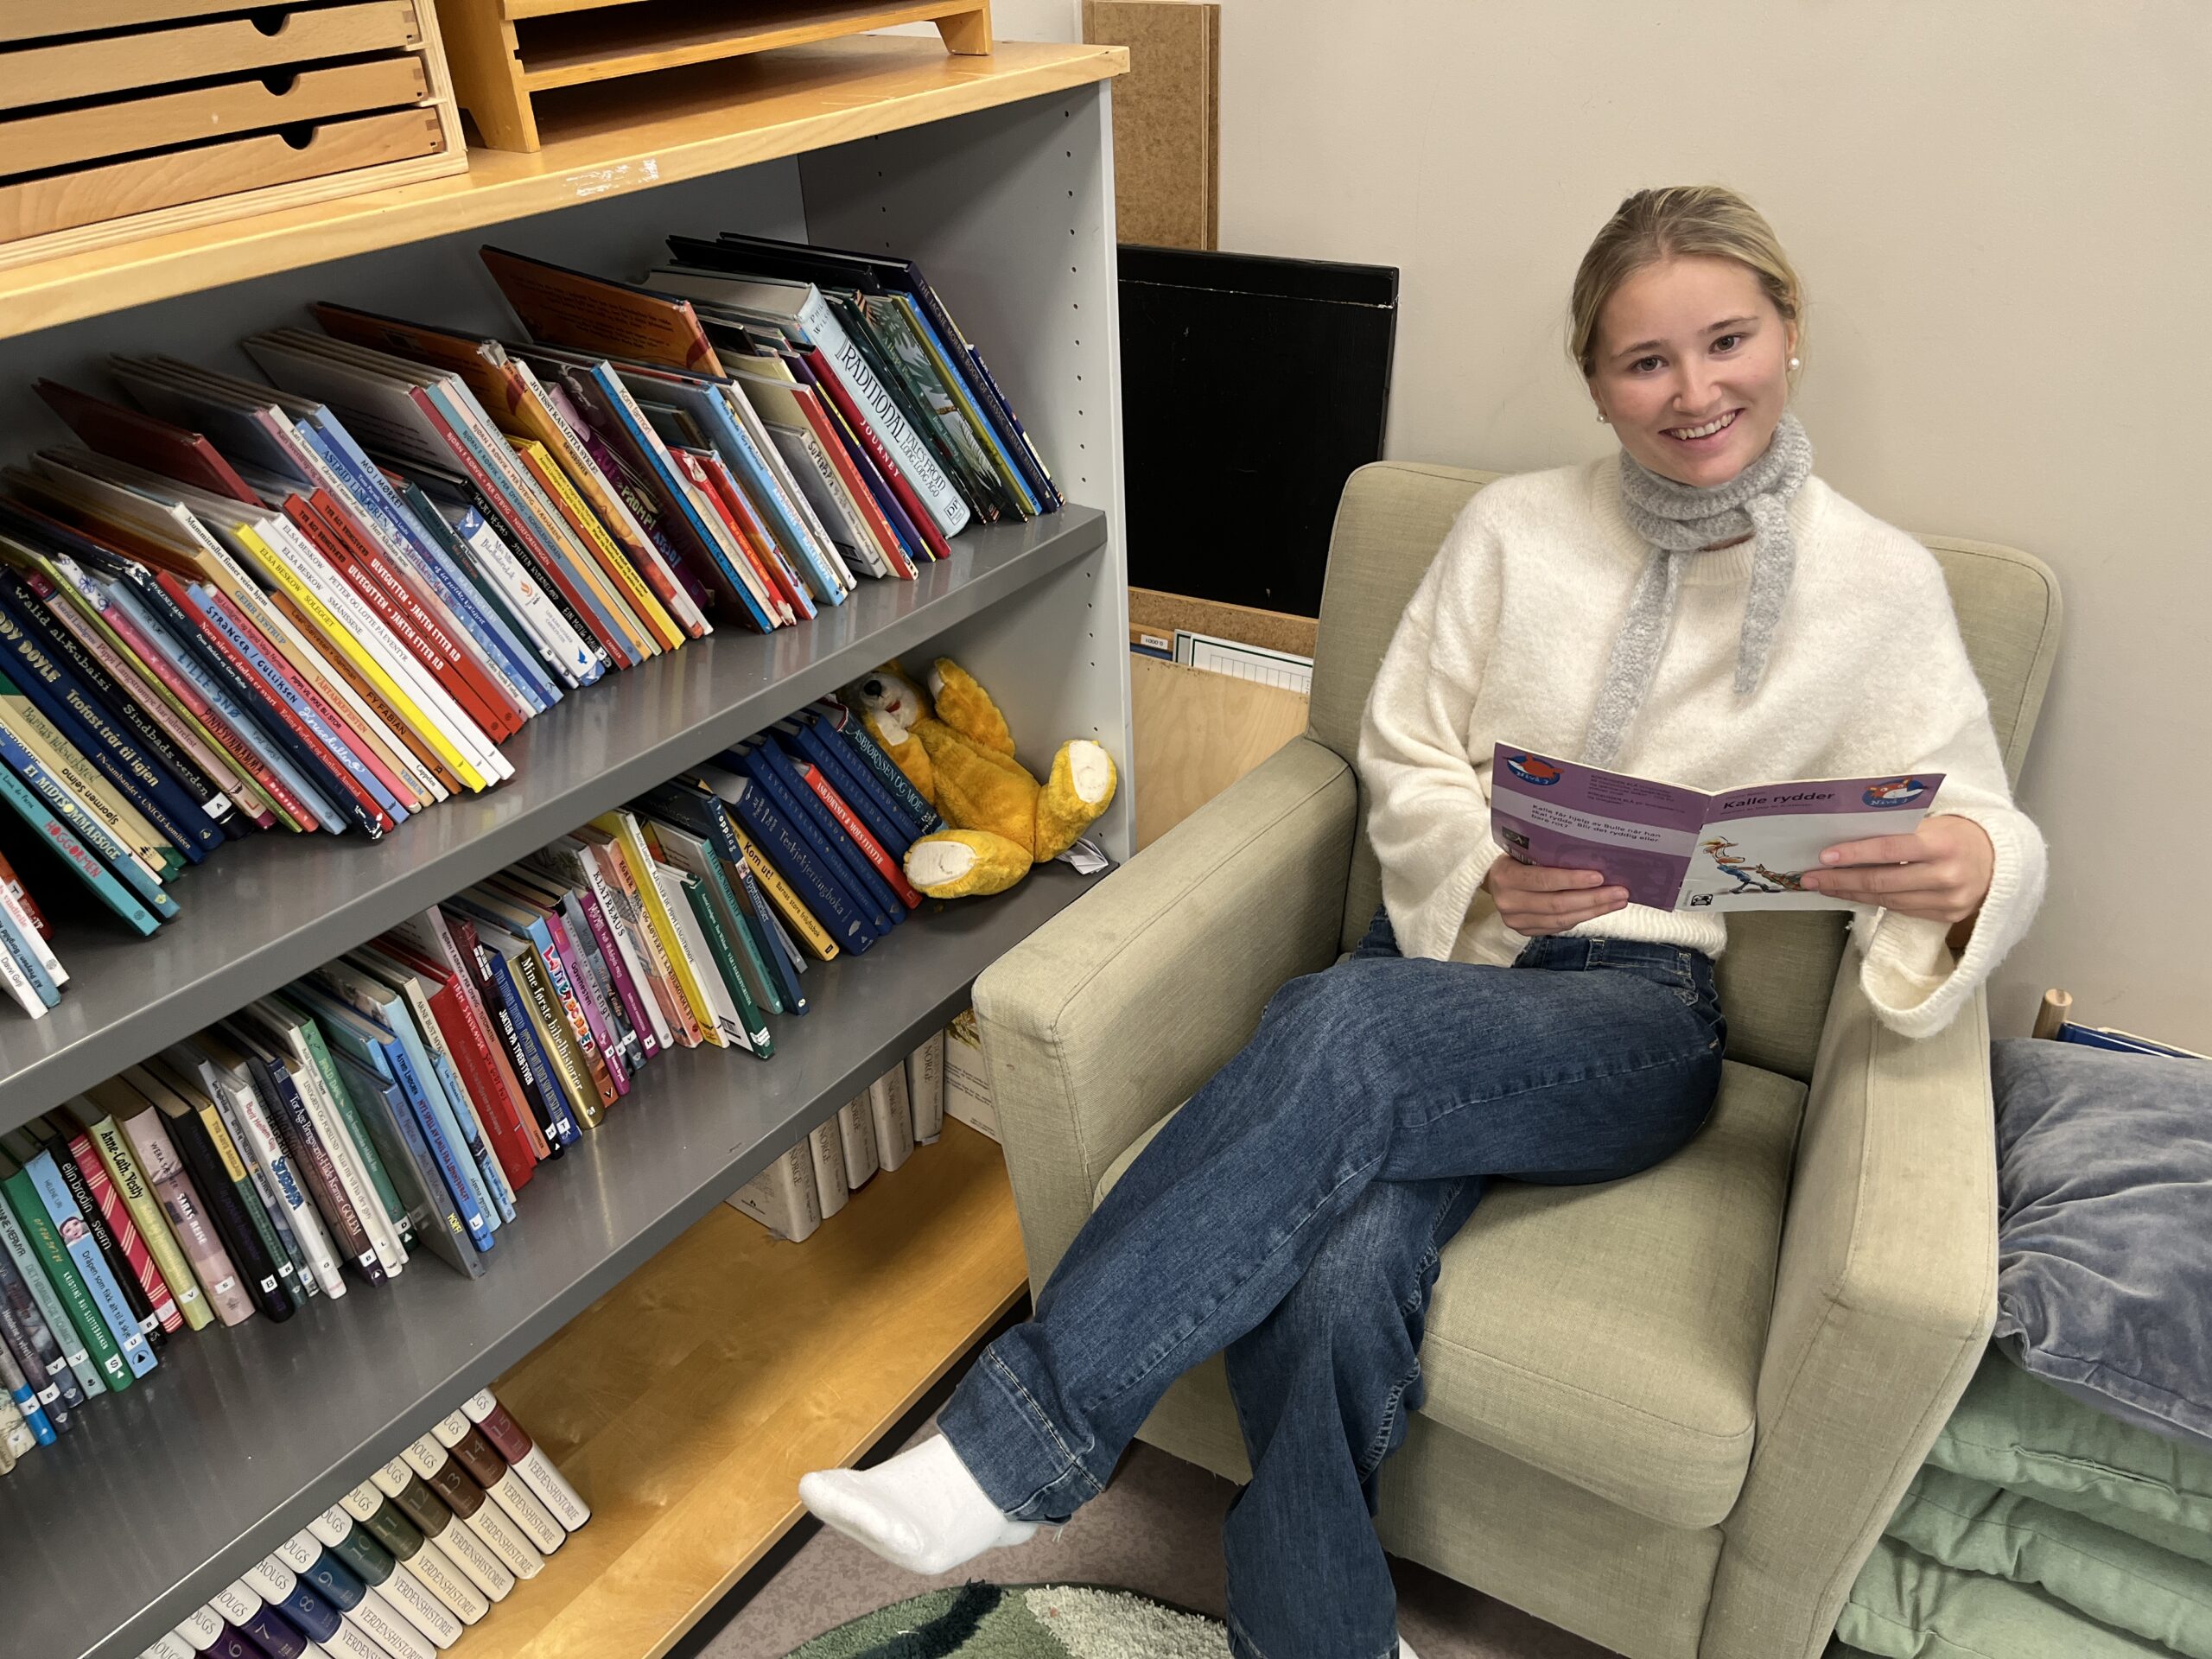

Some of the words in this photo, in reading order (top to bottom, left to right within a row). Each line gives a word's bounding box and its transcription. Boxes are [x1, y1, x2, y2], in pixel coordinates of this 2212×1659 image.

[915, 279, 931, 299] THE
[926, 298, 948, 326] JACKIE
[944, 327, 968, 359] MORRIS
[962, 358, 982, 383] BOOK
[977, 382, 988, 394] OF
[983, 394, 1007, 424] CLASSIC
[527, 379, 539, 392] JO
[533, 389, 556, 413] VISST
[550, 410, 566, 429] KAN
[560, 425, 583, 451] LOTTA
[835, 329, 905, 443] TRADITIONAL
[321, 448, 352, 483] ASTRID
[860, 418, 900, 477] JOURNEY
[359, 459, 374, 475] MO
[375, 478, 403, 509] MØRKET
[484, 481, 496, 494] PER
[184, 516, 225, 559] Mummitrollet
[221, 556, 241, 577] finner
[237, 574, 255, 593] veien
[251, 589, 270, 608] hjem
[259, 547, 277, 567] ELSA
[274, 563, 302, 593] BESKOW
[303, 594, 334, 627] SOLEGGET
[281, 546, 300, 566] ELSA
[296, 563, 323, 591] BESKOW
[282, 524, 300, 543] ELSA
[297, 541, 324, 569] BESKOW
[328, 575, 352, 600] PETTER
[348, 598, 359, 608] OG
[356, 606, 377, 628] LOTTE
[381, 633, 408, 662] EVENTYR
[346, 563, 389, 611] ULVEGUTTEN
[388, 610, 416, 640] JAKTEN
[410, 634, 435, 662] ETTER
[429, 656, 444, 671] ILD
[368, 557, 409, 603] ULVEGUTTEN
[409, 603, 435, 632] JAKTEN
[429, 627, 453, 652] ETTER
[446, 647, 461, 663] ILD
[199, 621, 219, 642] Noen
[15, 586, 52, 626] Walid
[121, 702, 176, 760] Sindbads
[173, 759, 209, 796] verden
[94, 642, 118, 665] Pippi
[154, 702, 169, 719] har
[17, 639, 60, 683] DOYLE
[65, 689, 105, 729] Trofast
[118, 744, 136, 761] til
[128, 756, 161, 790] igjen
[365, 691, 379, 706] FY
[376, 703, 407, 735] FABIAN
[84, 789, 118, 826] Sjøormen
[1723, 797, 1767, 810] Kalle
[1771, 792, 1835, 804] rydder
[741, 841, 760, 862] Kom
[589, 871, 627, 938] KLATREMUS
[496, 1008, 515, 1034] JAKTEN
[518, 956, 543, 988] Mine
[532, 987, 556, 1020] første
[545, 1019, 587, 1090] bibelhistorier
[126, 1172, 143, 1199] Vestly
[287, 1093, 301, 1108] Tor
[340, 1203, 362, 1236] GOLEM
[61, 1161, 79, 1182] elin
[70, 1179, 95, 1213] brodin
[90, 1219, 112, 1250] sverm
[62, 1271, 81, 1299] KRISTINE
[79, 1249, 99, 1276] Dråpen
[94, 1274, 106, 1289] som
[101, 1287, 114, 1302] fikk
[109, 1300, 119, 1313] alt
[113, 1310, 124, 1319] til
[408, 1487, 429, 1510] 12
[440, 1472, 461, 1495] 13
[528, 1457, 579, 1521] VERDENSHISTORIE
[502, 1482, 555, 1545] VERDENSHISTORIE
[351, 1536, 371, 1561] 10
[449, 1528, 506, 1590] VERDENSHISTORIE
[477, 1515, 534, 1573] VERDENSHISTORIE
[394, 1576, 454, 1637] VERDENSHISTORIE
[417, 1555, 476, 1616] VERDENSHISTORIE
